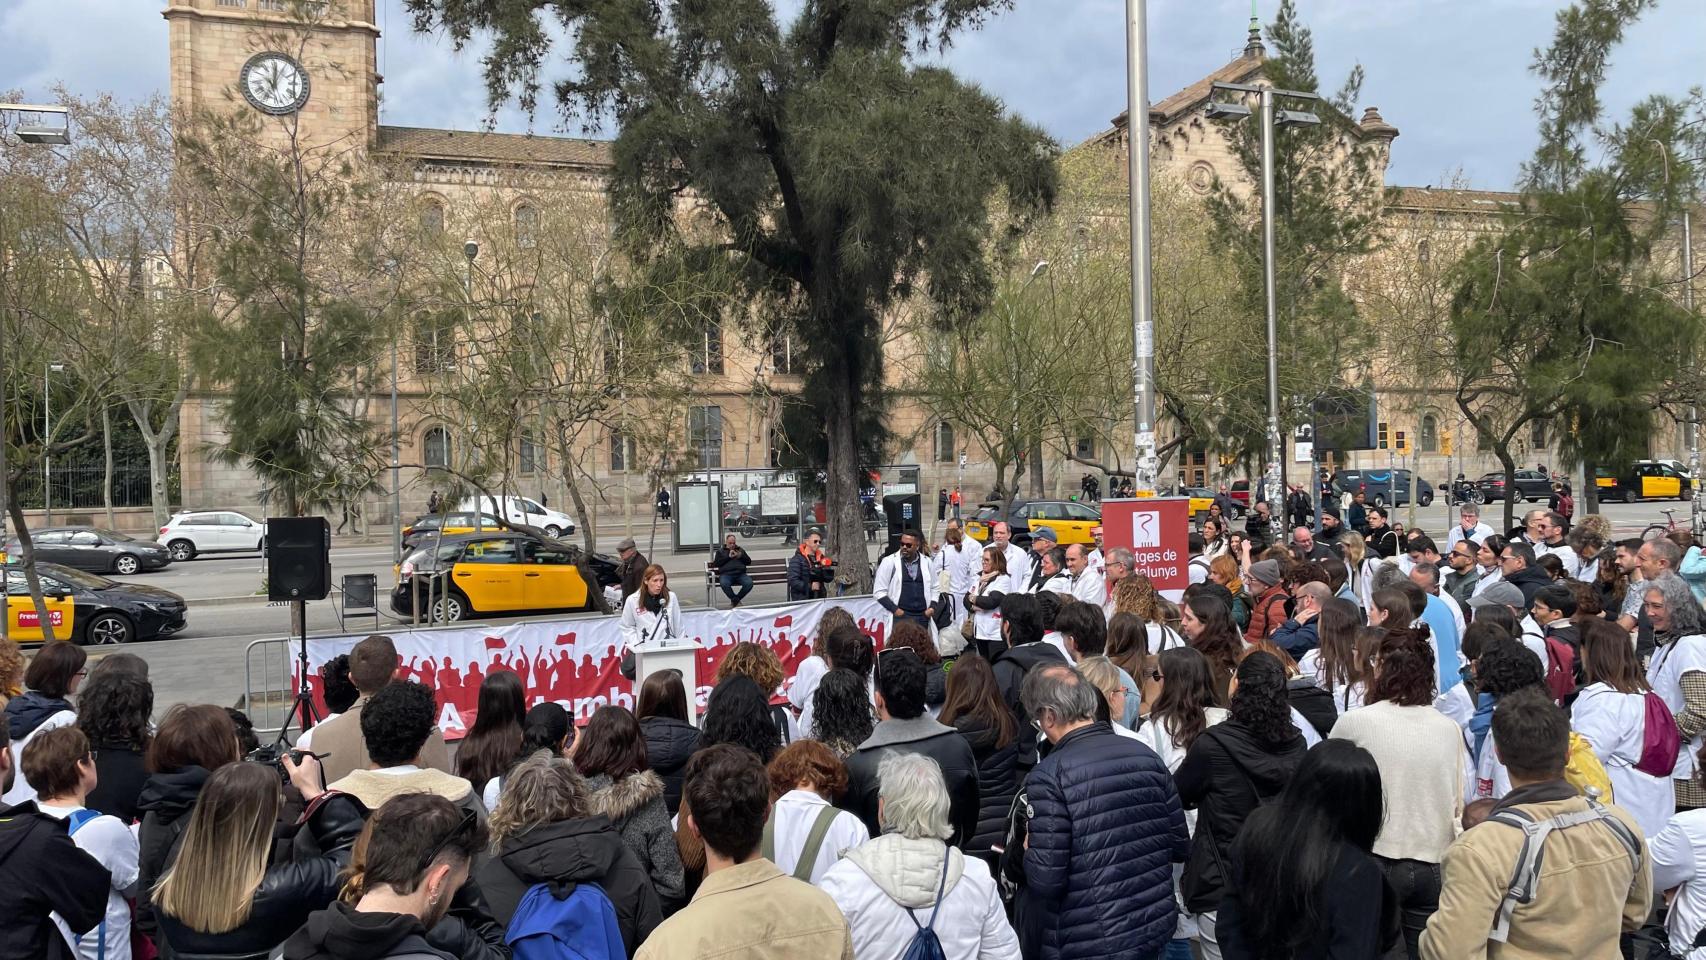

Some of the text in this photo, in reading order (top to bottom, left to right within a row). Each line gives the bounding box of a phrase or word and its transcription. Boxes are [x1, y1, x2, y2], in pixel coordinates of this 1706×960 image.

[1134, 549, 1177, 566] tges de
[1134, 566, 1177, 580] talunya
